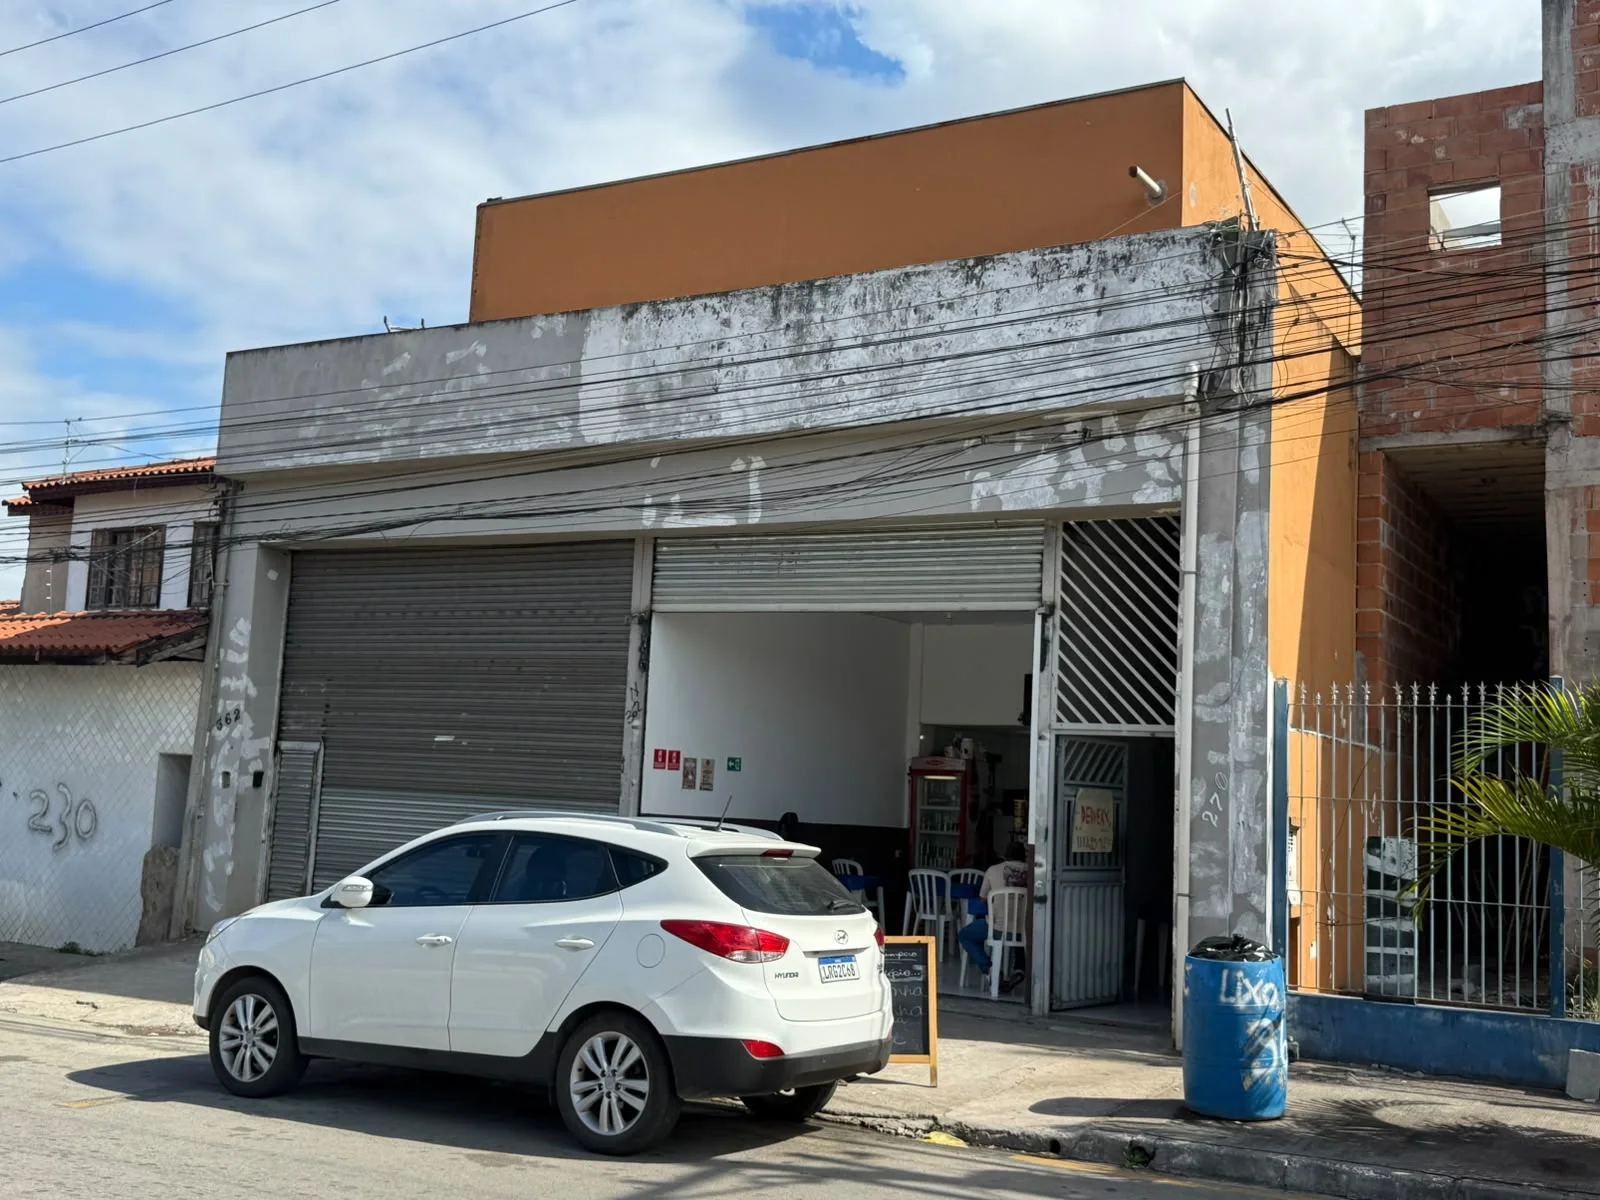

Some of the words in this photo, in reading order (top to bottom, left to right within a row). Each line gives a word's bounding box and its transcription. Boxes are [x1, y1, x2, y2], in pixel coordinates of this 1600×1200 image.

[28, 782, 98, 852] 230
[1202, 772, 1228, 828] 270
[823, 964, 856, 980] LRG2C68
